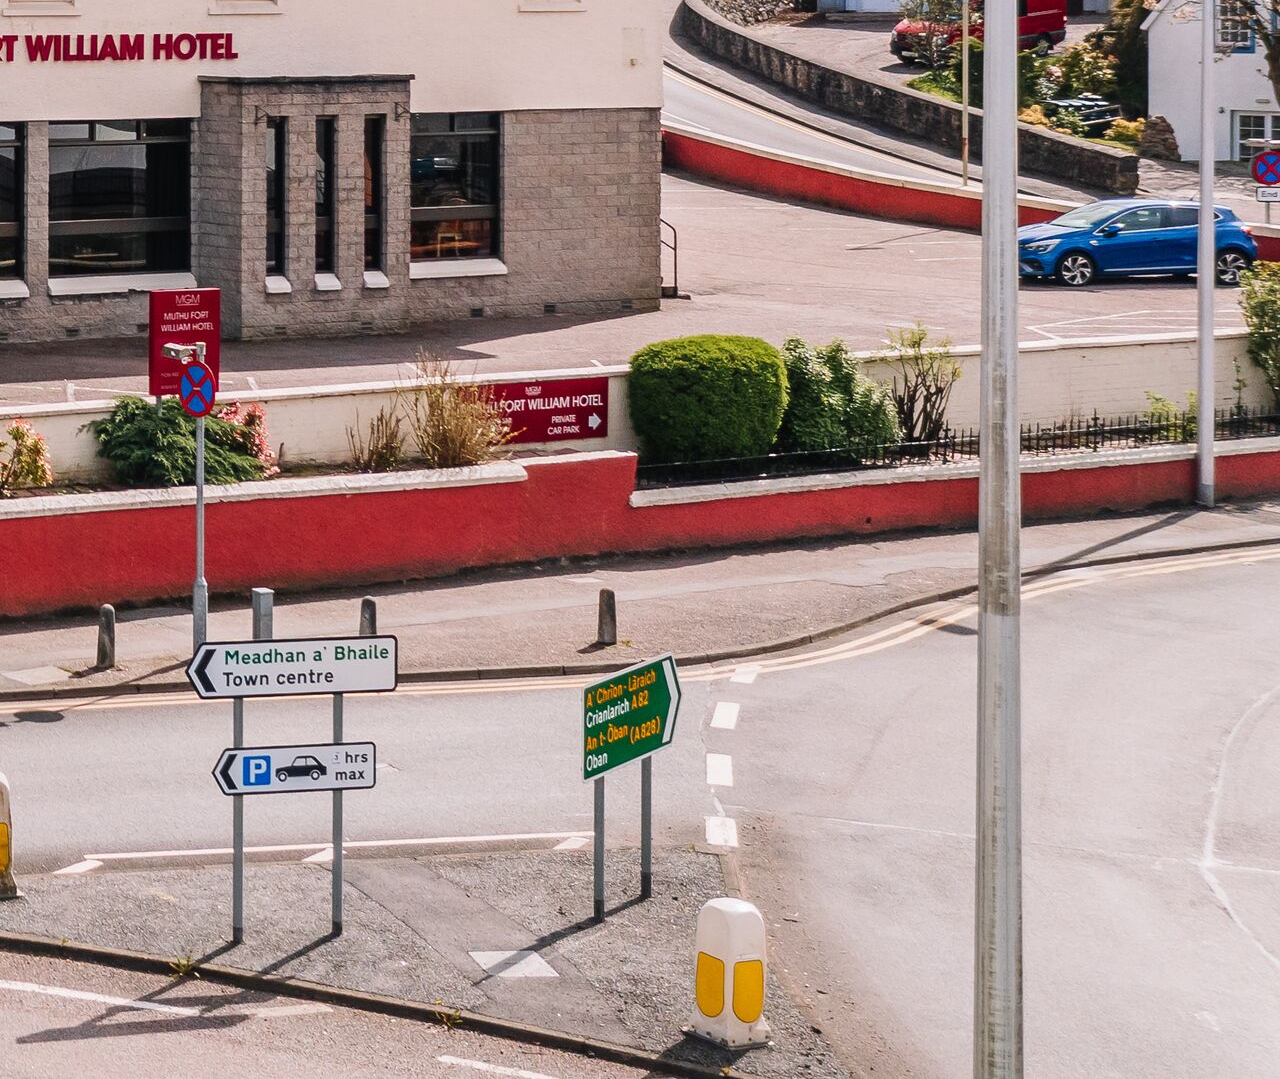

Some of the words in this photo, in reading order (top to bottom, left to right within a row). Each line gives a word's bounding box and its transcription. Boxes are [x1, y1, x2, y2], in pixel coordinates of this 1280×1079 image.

[25, 33, 144, 62] WILLIAM
[153, 32, 238, 60] HOTEL
[175, 294, 200, 304] MGM
[163, 312, 190, 321] MUTHU
[190, 310, 209, 320] FORT
[161, 323, 191, 332] WILLIAM
[192, 322, 214, 331] HOTEL
[528, 396, 570, 411] WILLIAM
[572, 394, 603, 407] HOTEL
[551, 414, 576, 423] PRIVATE
[547, 426, 562, 435] CAR
[563, 425, 580, 433] PARK
[225, 648, 306, 665] Meadhan
[335, 645, 389, 661] Bhaile
[223, 672, 269, 686] Town
[276, 670, 334, 685] centre
[586, 698, 630, 728] Crianlarich
[250, 759, 267, 782] P
[345, 751, 368, 763] hrs
[586, 753, 608, 771] Oban
[335, 770, 365, 780] max
